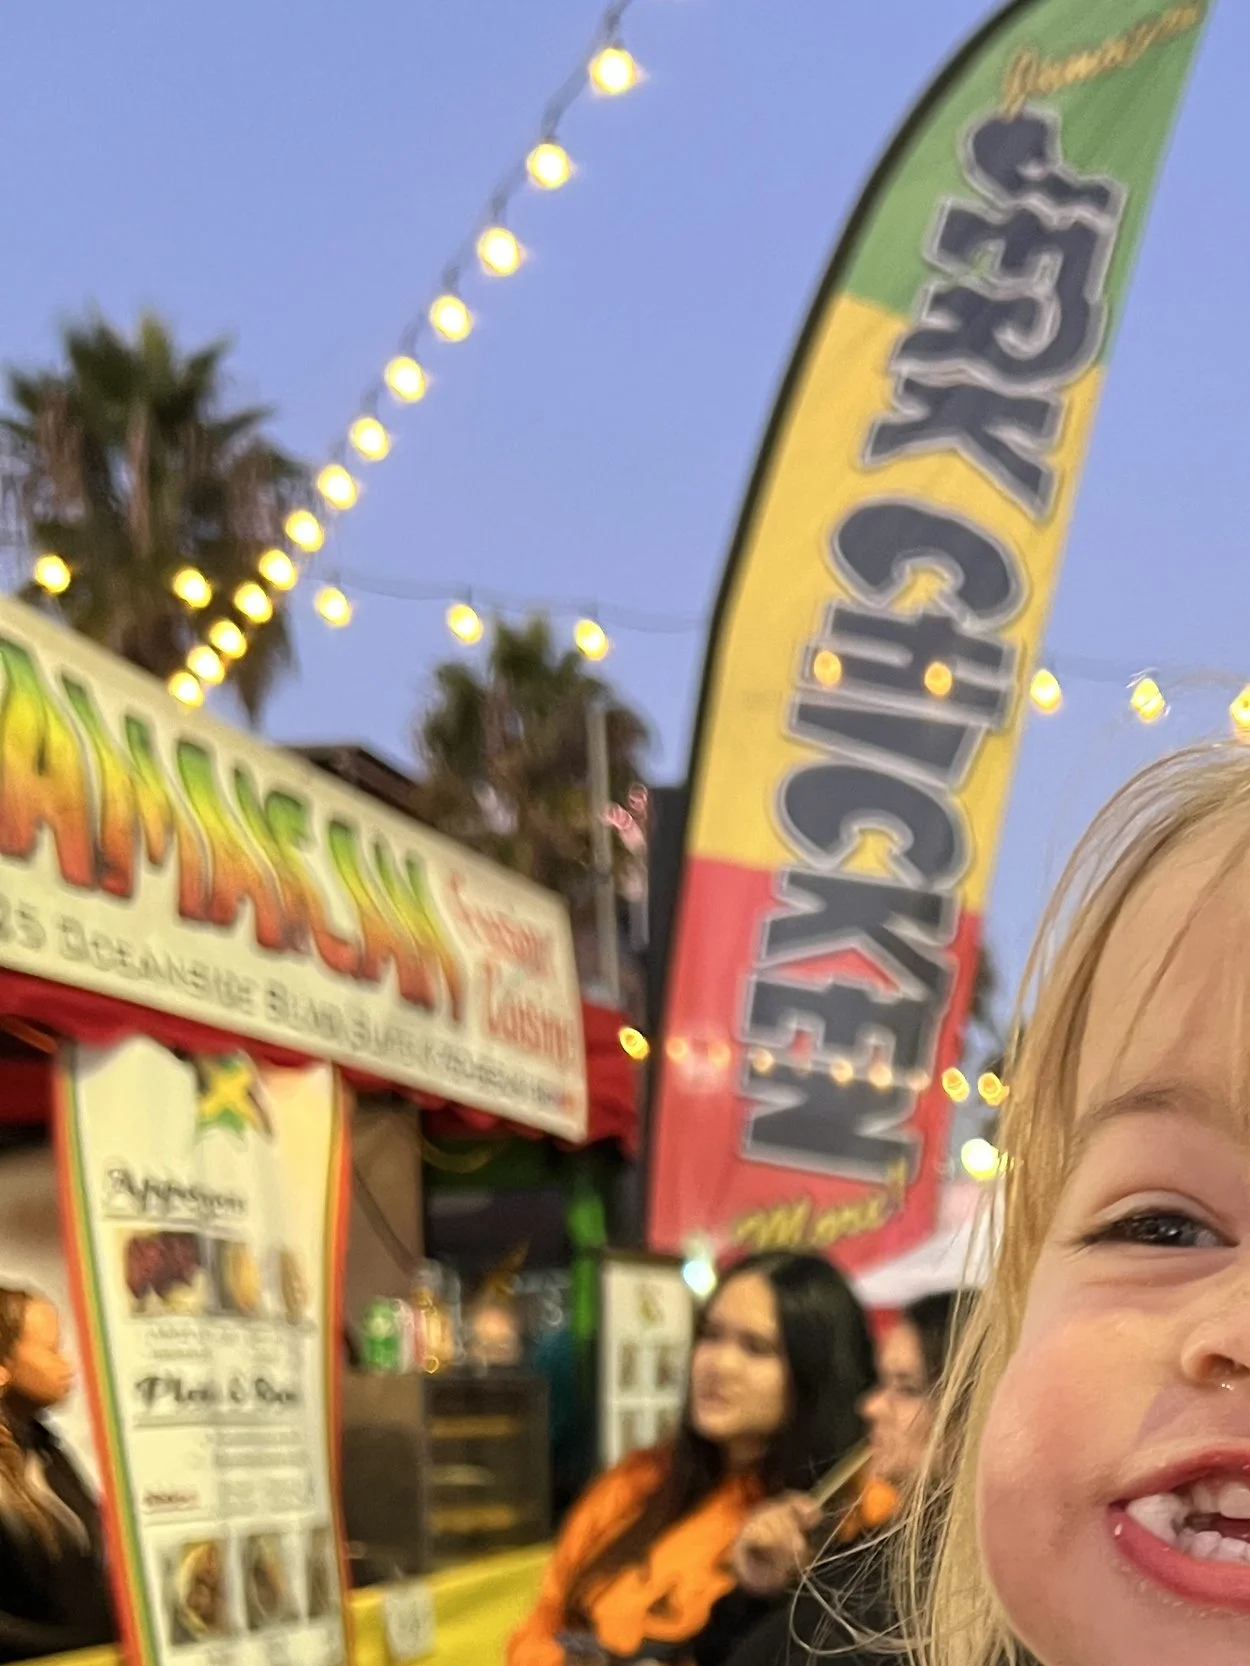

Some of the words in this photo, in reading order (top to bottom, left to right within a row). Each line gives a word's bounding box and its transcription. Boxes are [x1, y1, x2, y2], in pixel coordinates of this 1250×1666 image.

[860, 102, 1127, 524] JERK
[58, 912, 258, 1014] OCEANSIDE
[736, 489, 1027, 1185] CHICKEN
